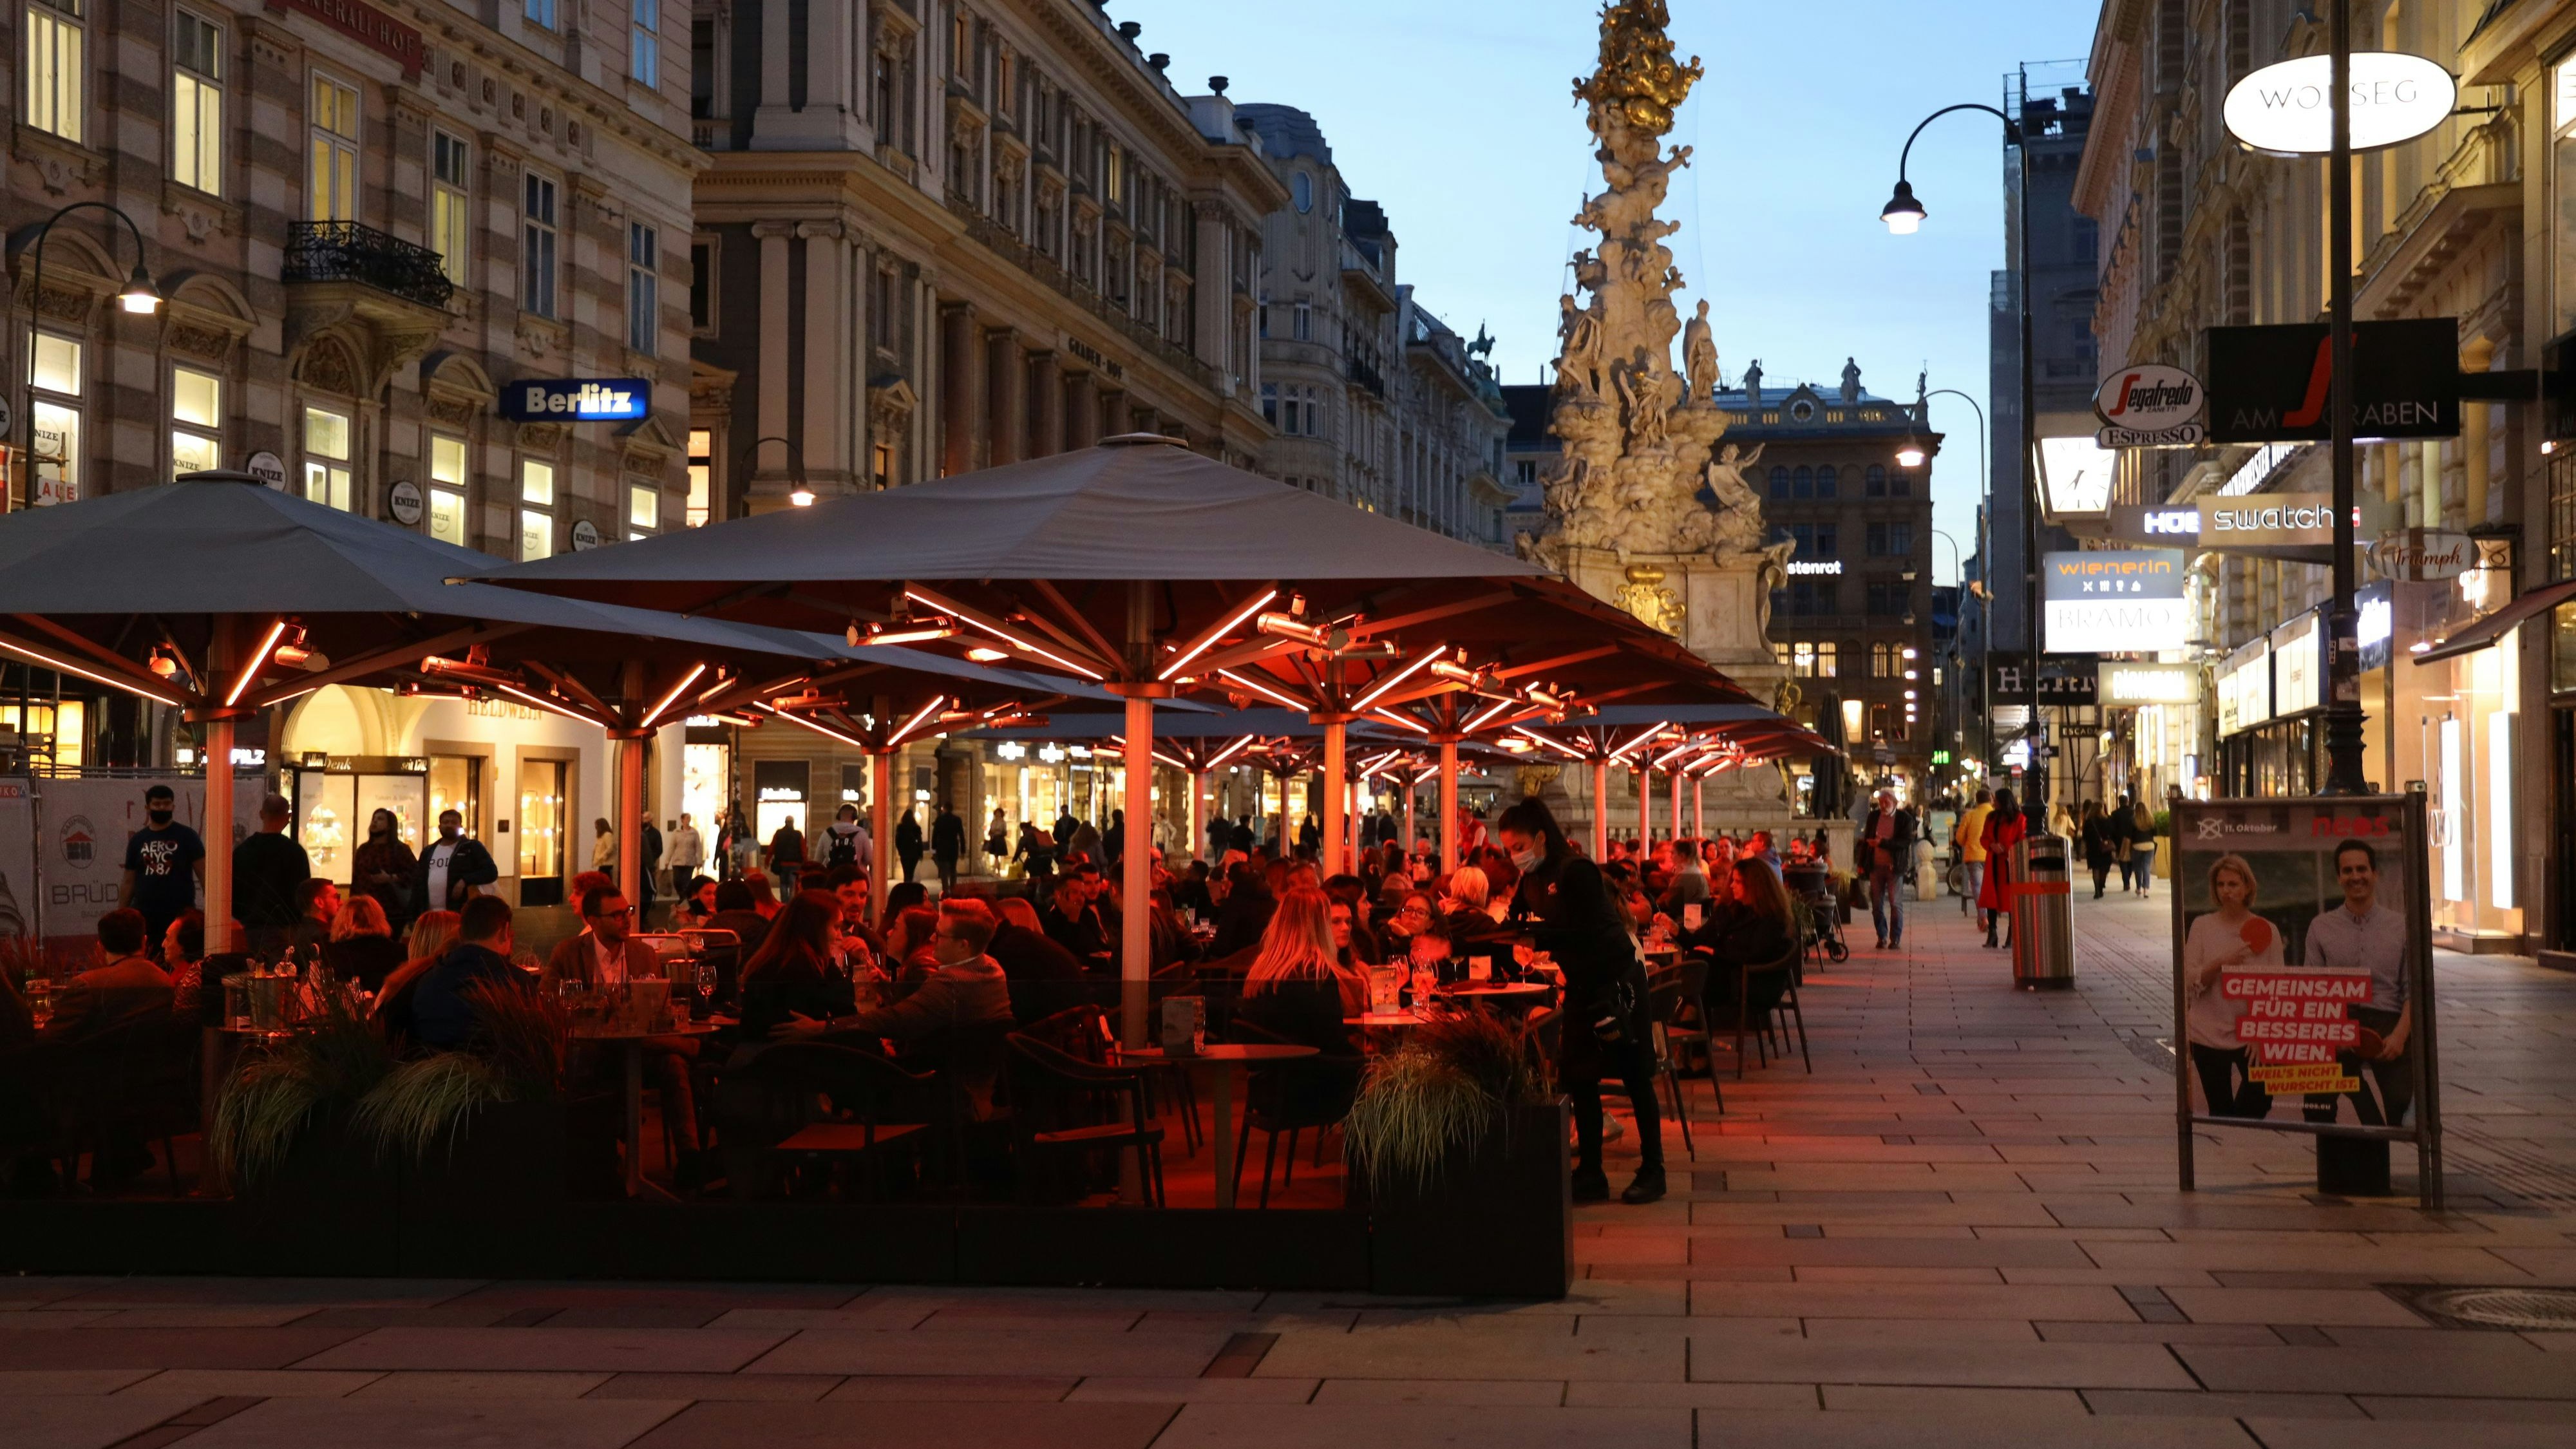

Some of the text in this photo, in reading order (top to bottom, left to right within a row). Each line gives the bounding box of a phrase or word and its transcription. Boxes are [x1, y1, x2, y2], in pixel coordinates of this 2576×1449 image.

[2259, 79, 2417, 109] WOSEG
[526, 383, 632, 413] Berlitz
[2108, 374, 2193, 416] Segafredo
[34, 428, 59, 442] NIZE
[2108, 426, 2197, 445] ESPRESSO
[251, 466, 283, 482] KNIZE
[394, 495, 421, 509] KNIZE
[2214, 503, 2334, 531] swatch
[576, 533, 596, 545] KNIZE
[2058, 559, 2172, 576] wienerin
[2382, 542, 2463, 574] Triumph
[2058, 607, 2170, 629] BRAMO
[468, 699, 542, 720] HELDWEIN
[2224, 823, 2278, 833] 11. Oktober
[140, 840, 178, 853] AERO
[2226, 978, 2367, 998] GEMEINSAM
[2251, 996, 2343, 1019] FÜR EIN
[2240, 1021, 2356, 1041] BESSERES
[2263, 1042, 2333, 1063] WIEN.
[2250, 1066, 2339, 1079] WEIL'S NICHT
[2266, 1079, 2358, 1092] WURSCHT IST.
